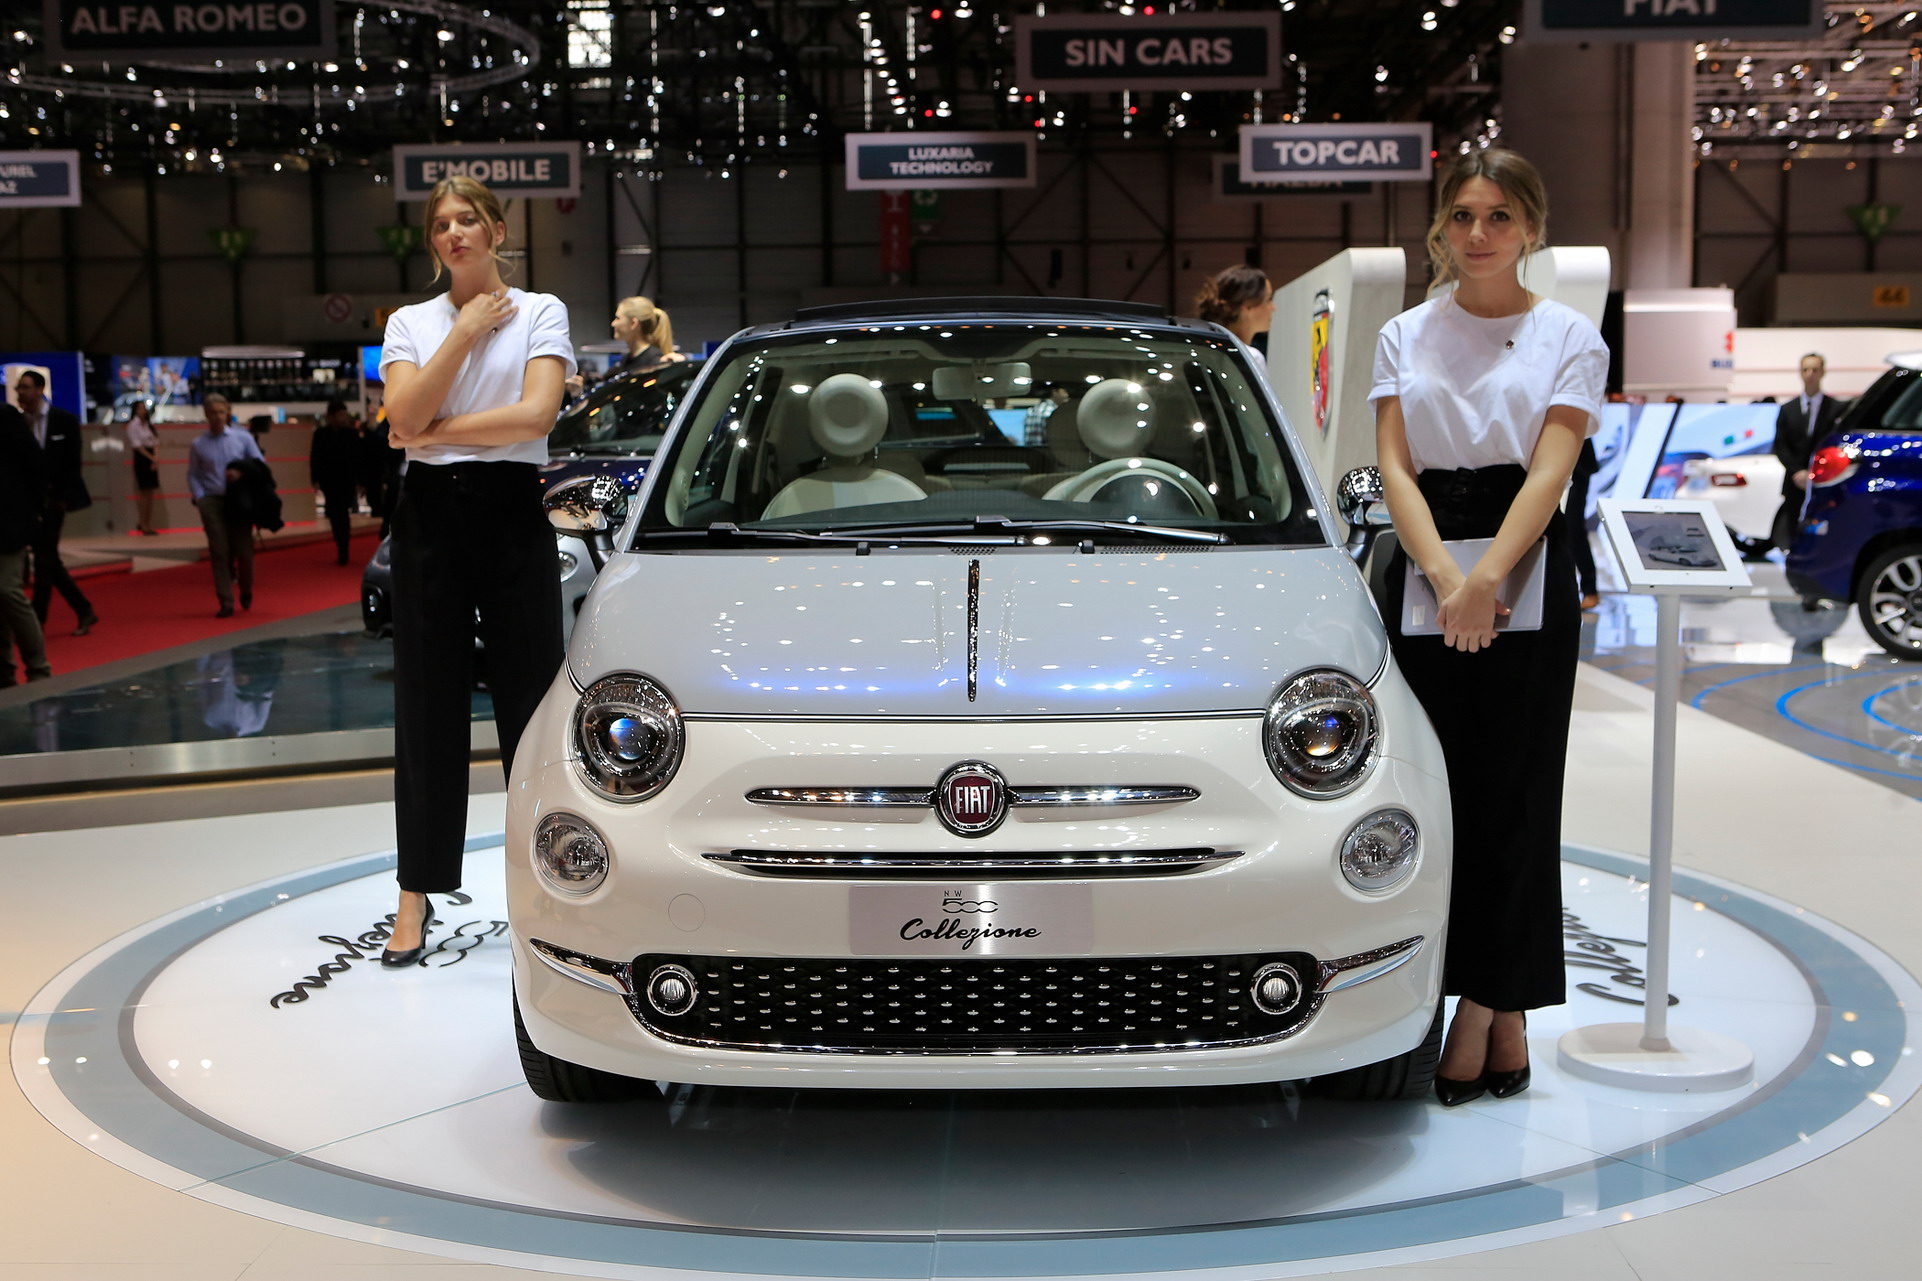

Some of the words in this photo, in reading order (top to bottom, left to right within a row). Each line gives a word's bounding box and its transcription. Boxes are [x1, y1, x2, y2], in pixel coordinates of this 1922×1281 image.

[71, 6, 164, 34] ALFA
[174, 4, 307, 32] ROMEO
[1065, 40, 1125, 66] SIN
[1136, 38, 1233, 65] CARS
[908, 147, 975, 160] LUXARIA
[1273, 140, 1400, 166] TOPCAR
[889, 161, 994, 175] TECHNOLOGY
[955, 786, 990, 814] FIAT
[942, 898, 998, 914] 500
[900, 918, 1041, 950] Collezione
